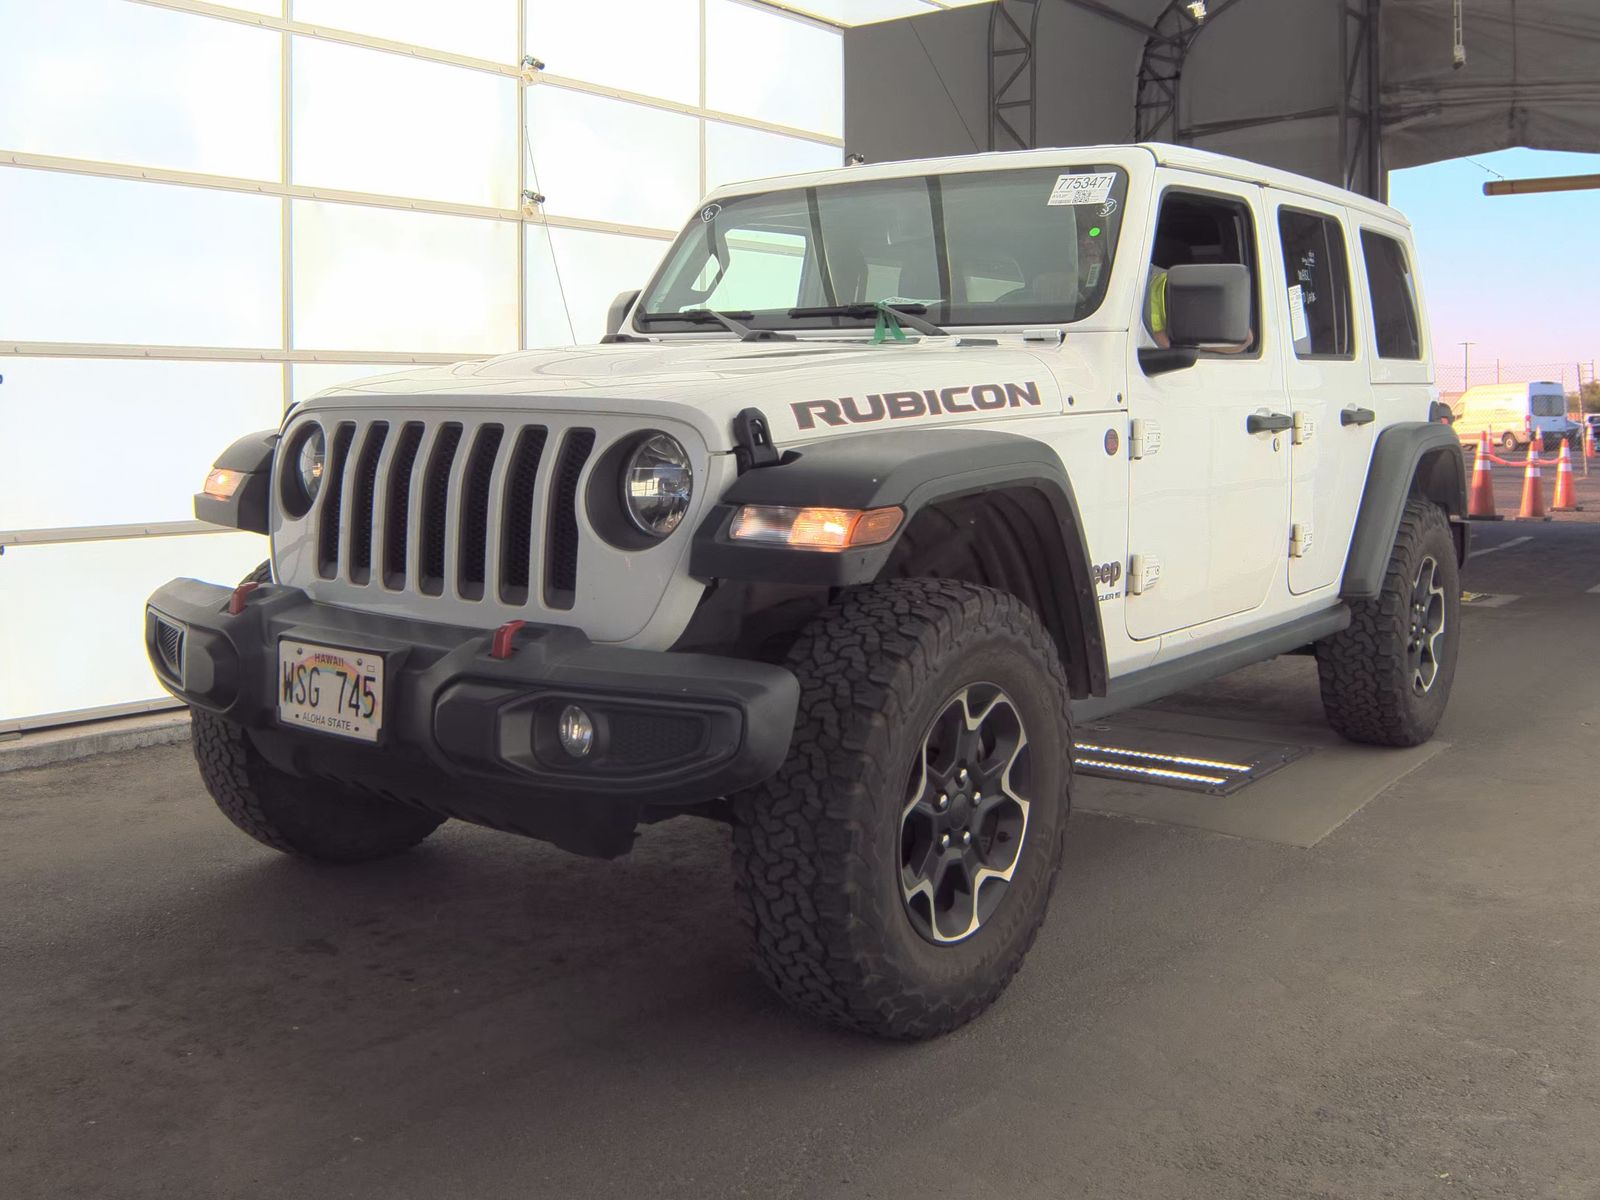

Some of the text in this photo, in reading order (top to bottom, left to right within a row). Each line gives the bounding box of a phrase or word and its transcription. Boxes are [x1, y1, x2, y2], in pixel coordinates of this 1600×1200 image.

[1058, 176, 1113, 190] 7753471
[790, 381, 1042, 430] RUBICON
[1092, 560, 1121, 587] eep
[314, 653, 344, 667] HAWAII
[283, 660, 377, 719] WSG 745
[302, 711, 352, 731] ALOHA STATE
